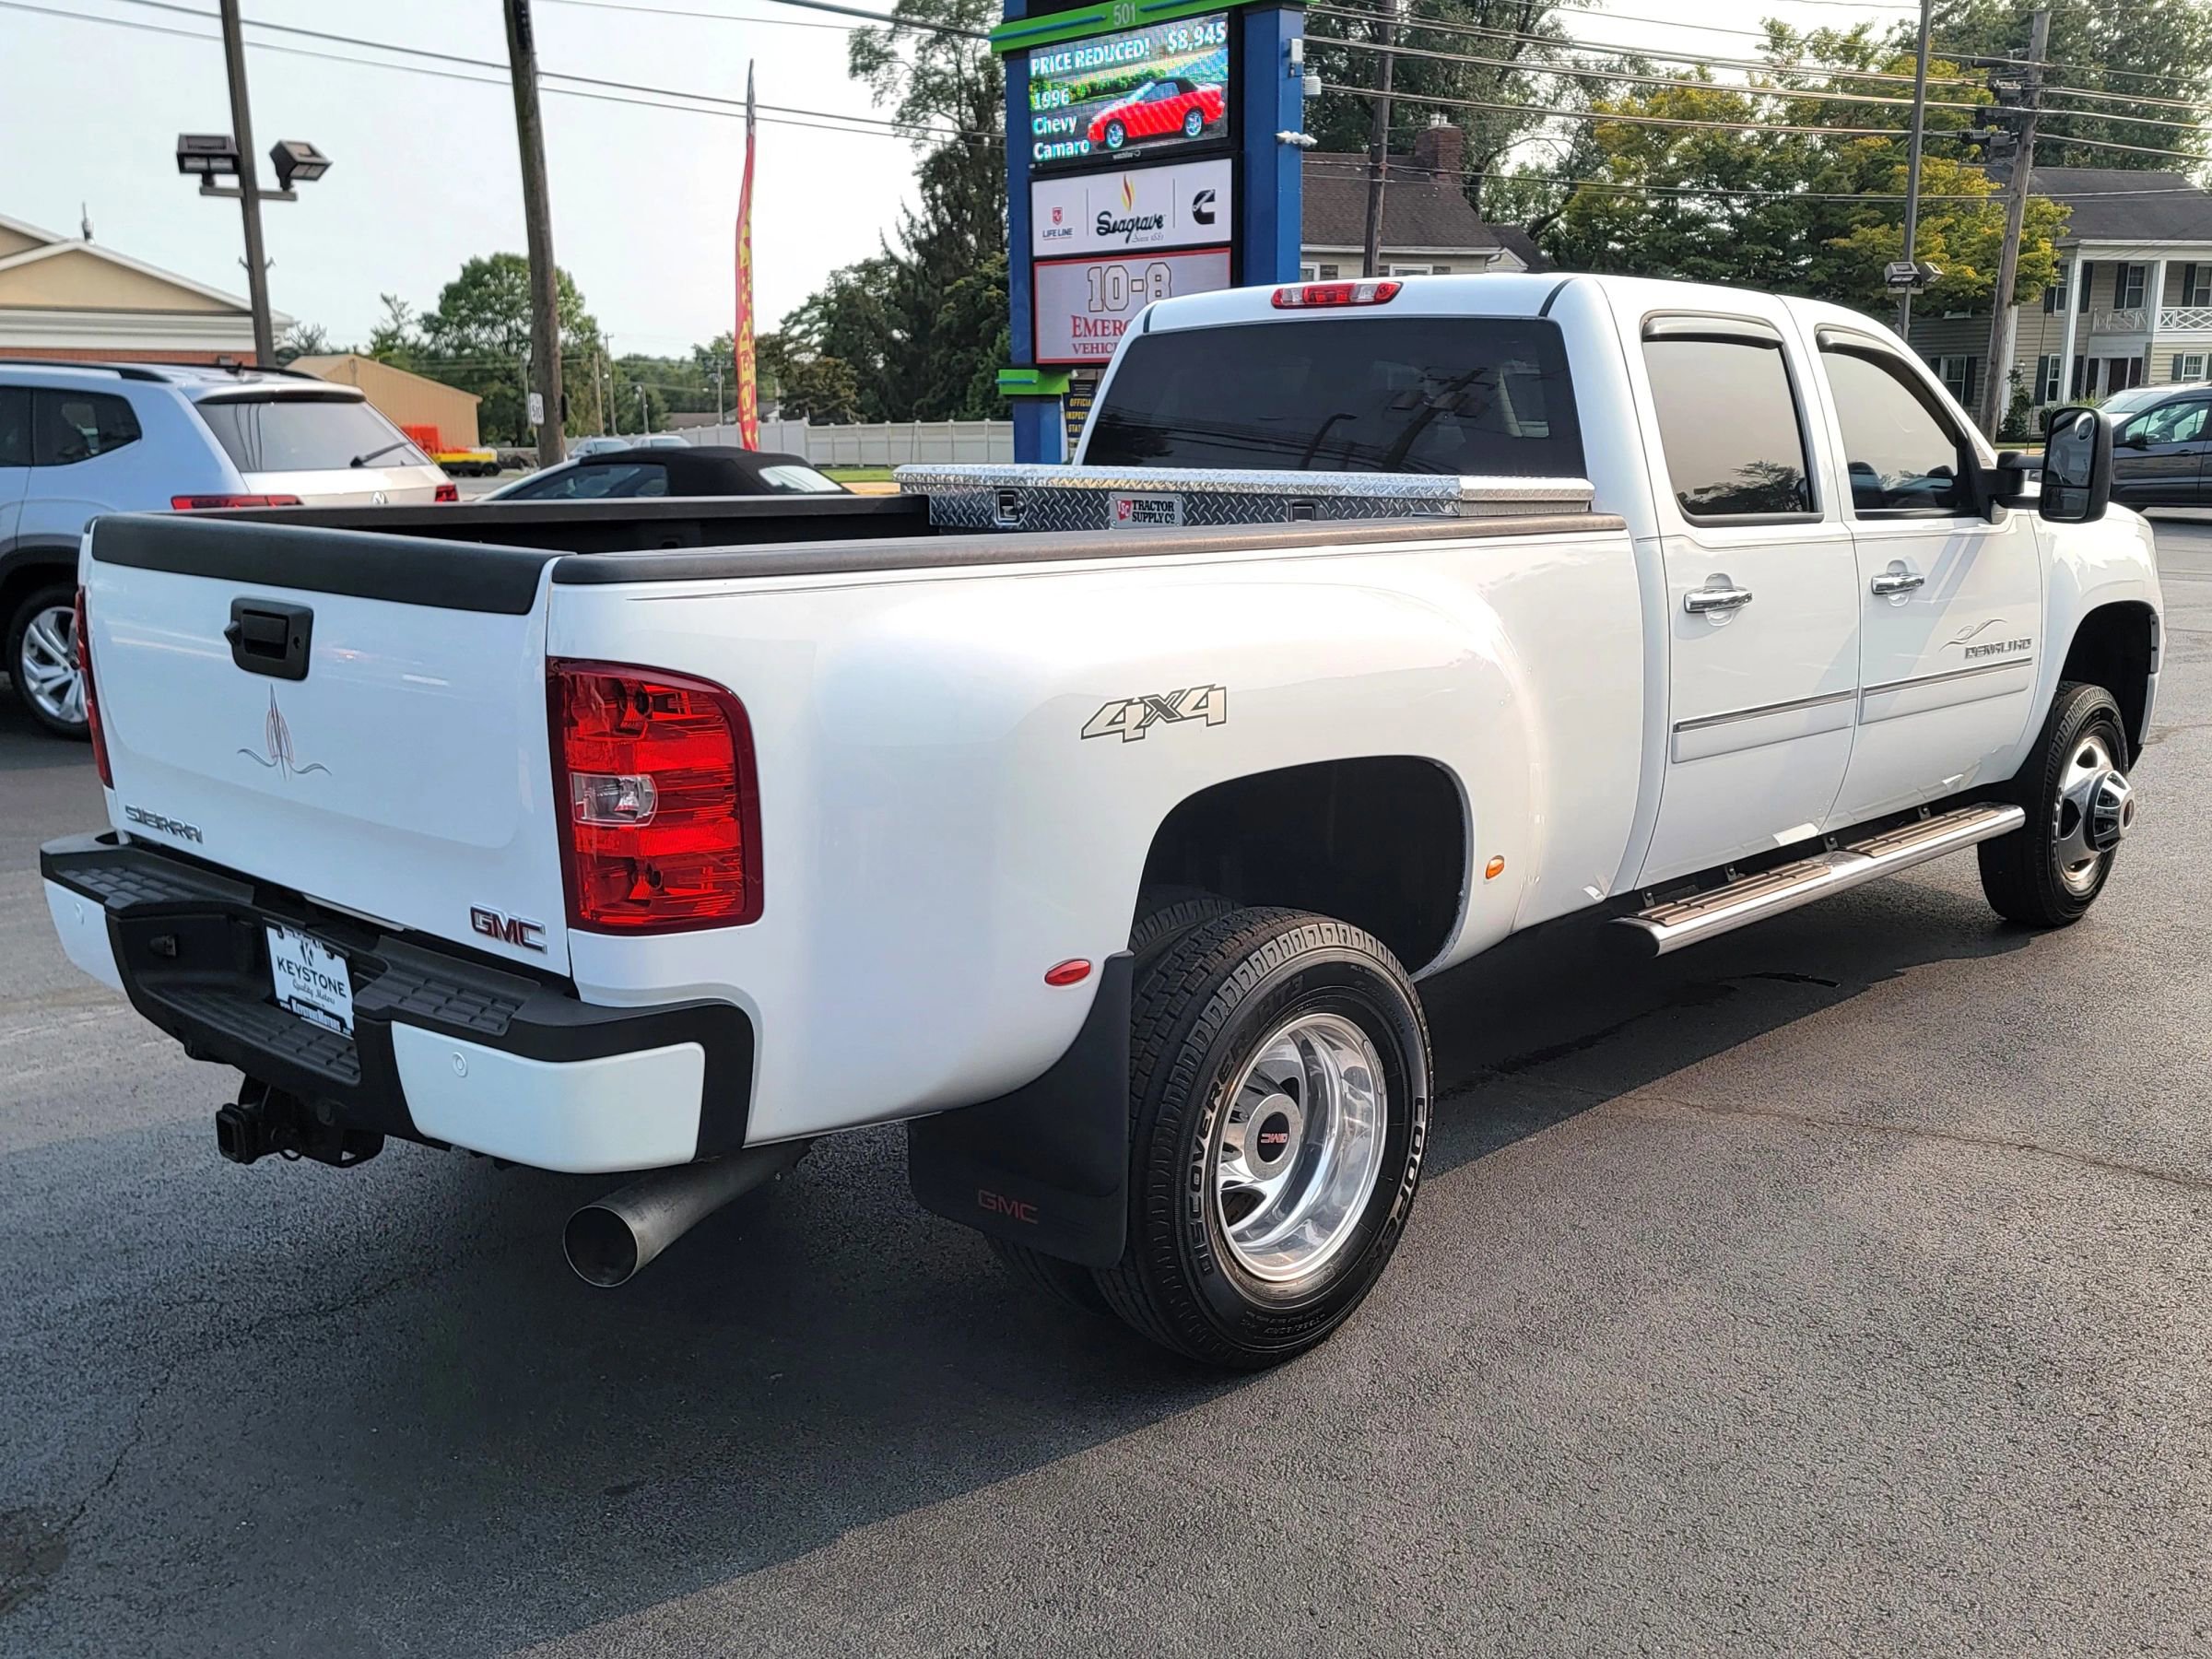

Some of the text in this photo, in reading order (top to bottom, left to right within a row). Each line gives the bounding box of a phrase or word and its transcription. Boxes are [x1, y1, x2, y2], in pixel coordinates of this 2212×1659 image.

[1113, 3, 1136, 26] 501
[1030, 21, 1228, 76] PRICE REDUCED! $8,945
[1033, 88, 1070, 111] 1996
[1032, 115, 1077, 136] Chevy
[1032, 138, 1090, 160] Camaro
[1042, 228, 1073, 238] LIFE LINE
[1096, 210, 1164, 244] Seagrave
[1087, 262, 1172, 312] 10-8
[1117, 500, 1130, 517] TSC
[1132, 500, 1175, 512] TRACTOR
[1132, 512, 1164, 524] SUPPLY
[124, 804, 204, 845] SIERRA
[469, 902, 548, 955] GMC
[276, 955, 347, 999] KEYSTONE
[1260, 1133, 1288, 1144] GMC
[978, 1188, 1039, 1225] GMC
